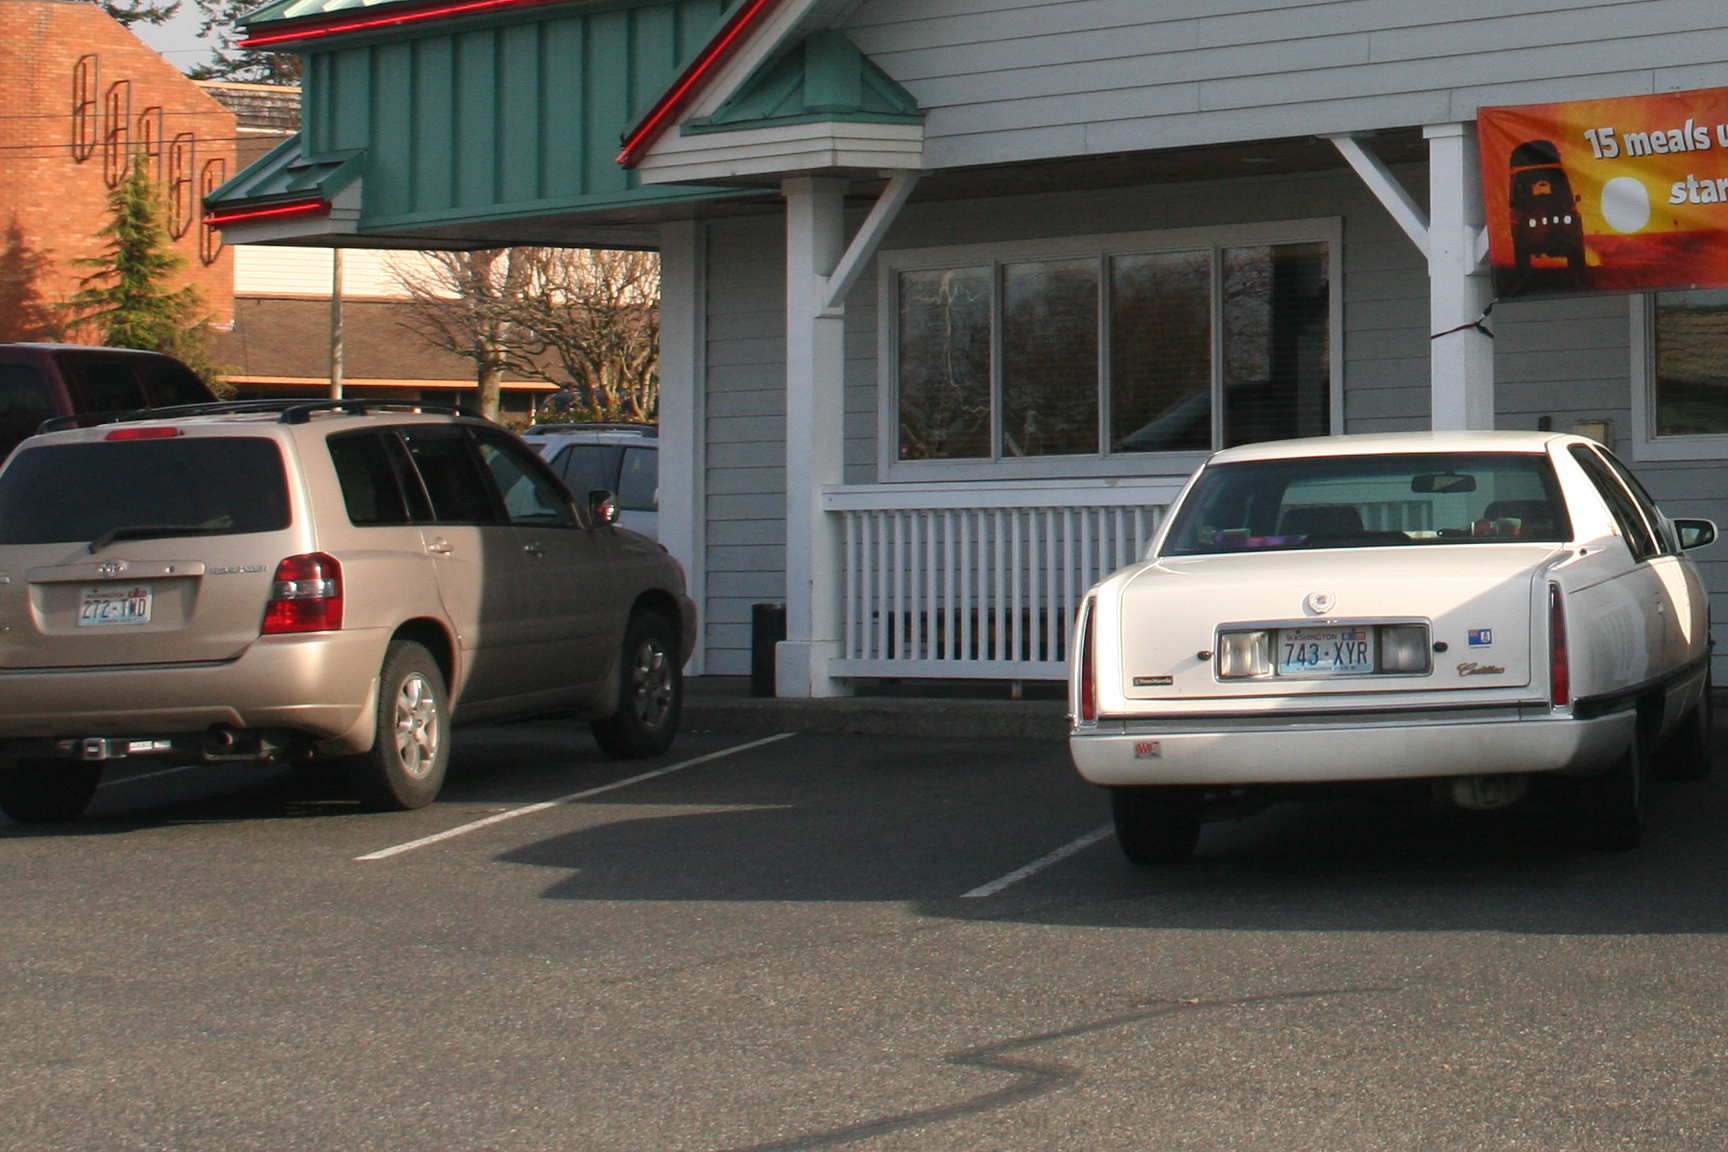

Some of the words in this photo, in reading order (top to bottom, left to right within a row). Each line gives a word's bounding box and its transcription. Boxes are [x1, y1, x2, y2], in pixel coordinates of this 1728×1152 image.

[1584, 127, 1619, 159] 15
[1623, 118, 1711, 156] meals
[1286, 633, 1337, 641] WASHINGTON
